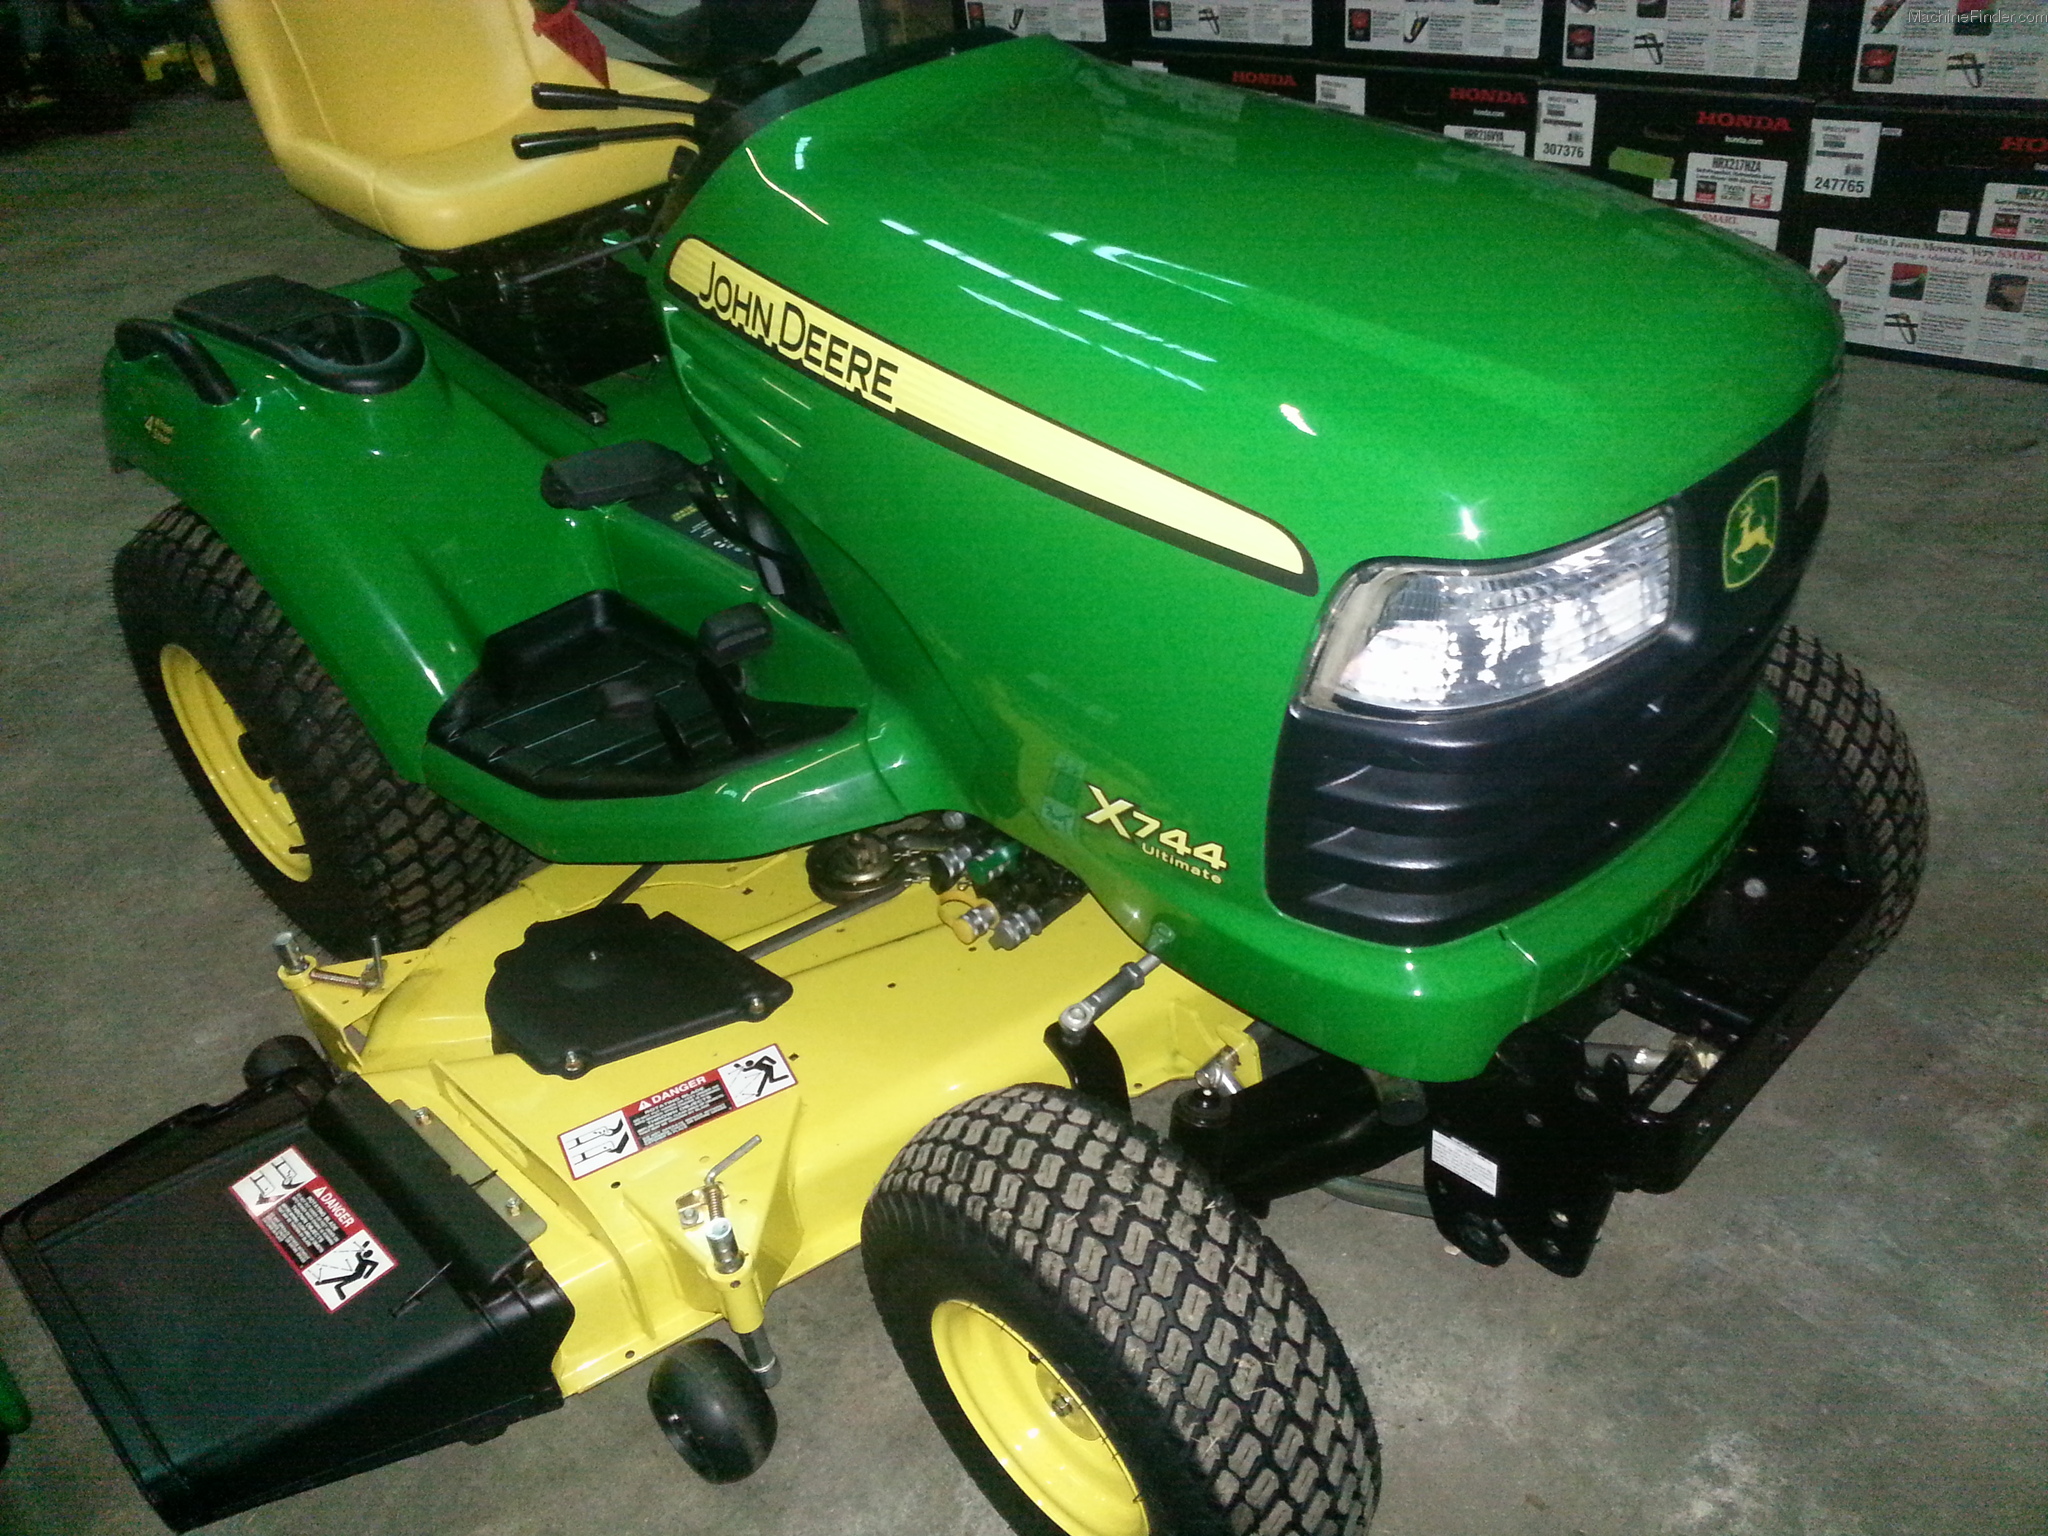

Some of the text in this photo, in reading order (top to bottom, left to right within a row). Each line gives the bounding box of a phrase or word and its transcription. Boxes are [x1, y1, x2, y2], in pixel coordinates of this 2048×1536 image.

[1232, 71, 1298, 86] HONDA
[1449, 87, 1528, 105] HONDA
[1697, 111, 1793, 132] HONDA
[1542, 142, 1584, 159] 307376
[1814, 176, 1865, 194] 247765
[699, 261, 899, 405] JOHN DEERE
[1084, 783, 1228, 871] X744
[1141, 841, 1223, 885] Ultimate
[650, 1075, 707, 1105] DANGER
[320, 1192, 356, 1229] DANGER
